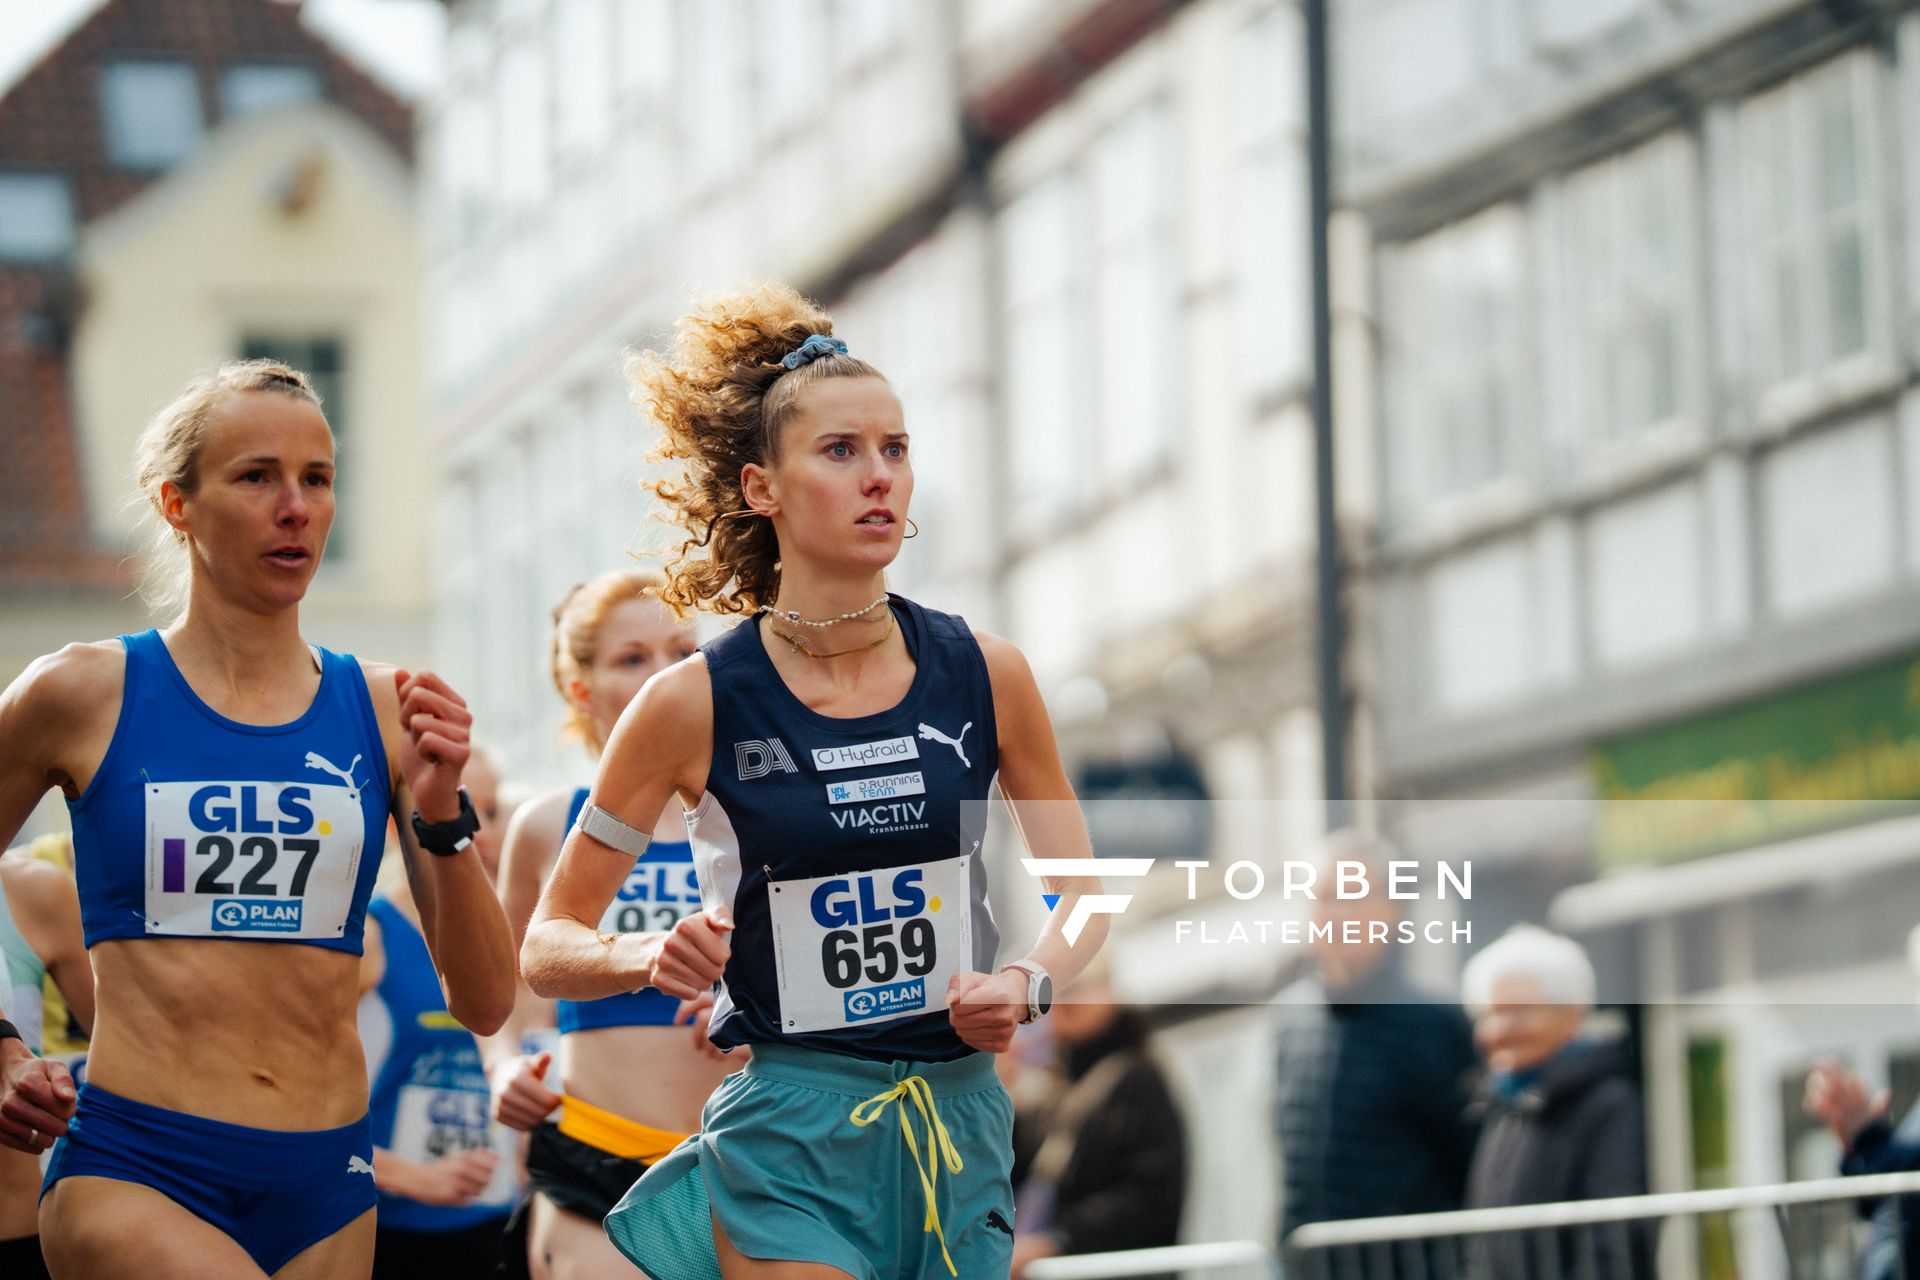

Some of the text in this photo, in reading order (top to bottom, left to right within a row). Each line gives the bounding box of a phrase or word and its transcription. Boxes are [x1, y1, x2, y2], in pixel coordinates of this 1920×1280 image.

[839, 739, 908, 765] Hydraid
[860, 787, 896, 799] TEAM
[830, 801, 926, 829] VIACTIV
[869, 823, 929, 834] Krankenkasse
[194, 835, 320, 897] 227
[250, 905, 299, 920] PLAN
[822, 918, 937, 989] 659
[879, 985, 922, 1005] PLAN
[880, 1001, 922, 1012] INTERNATIONAL
